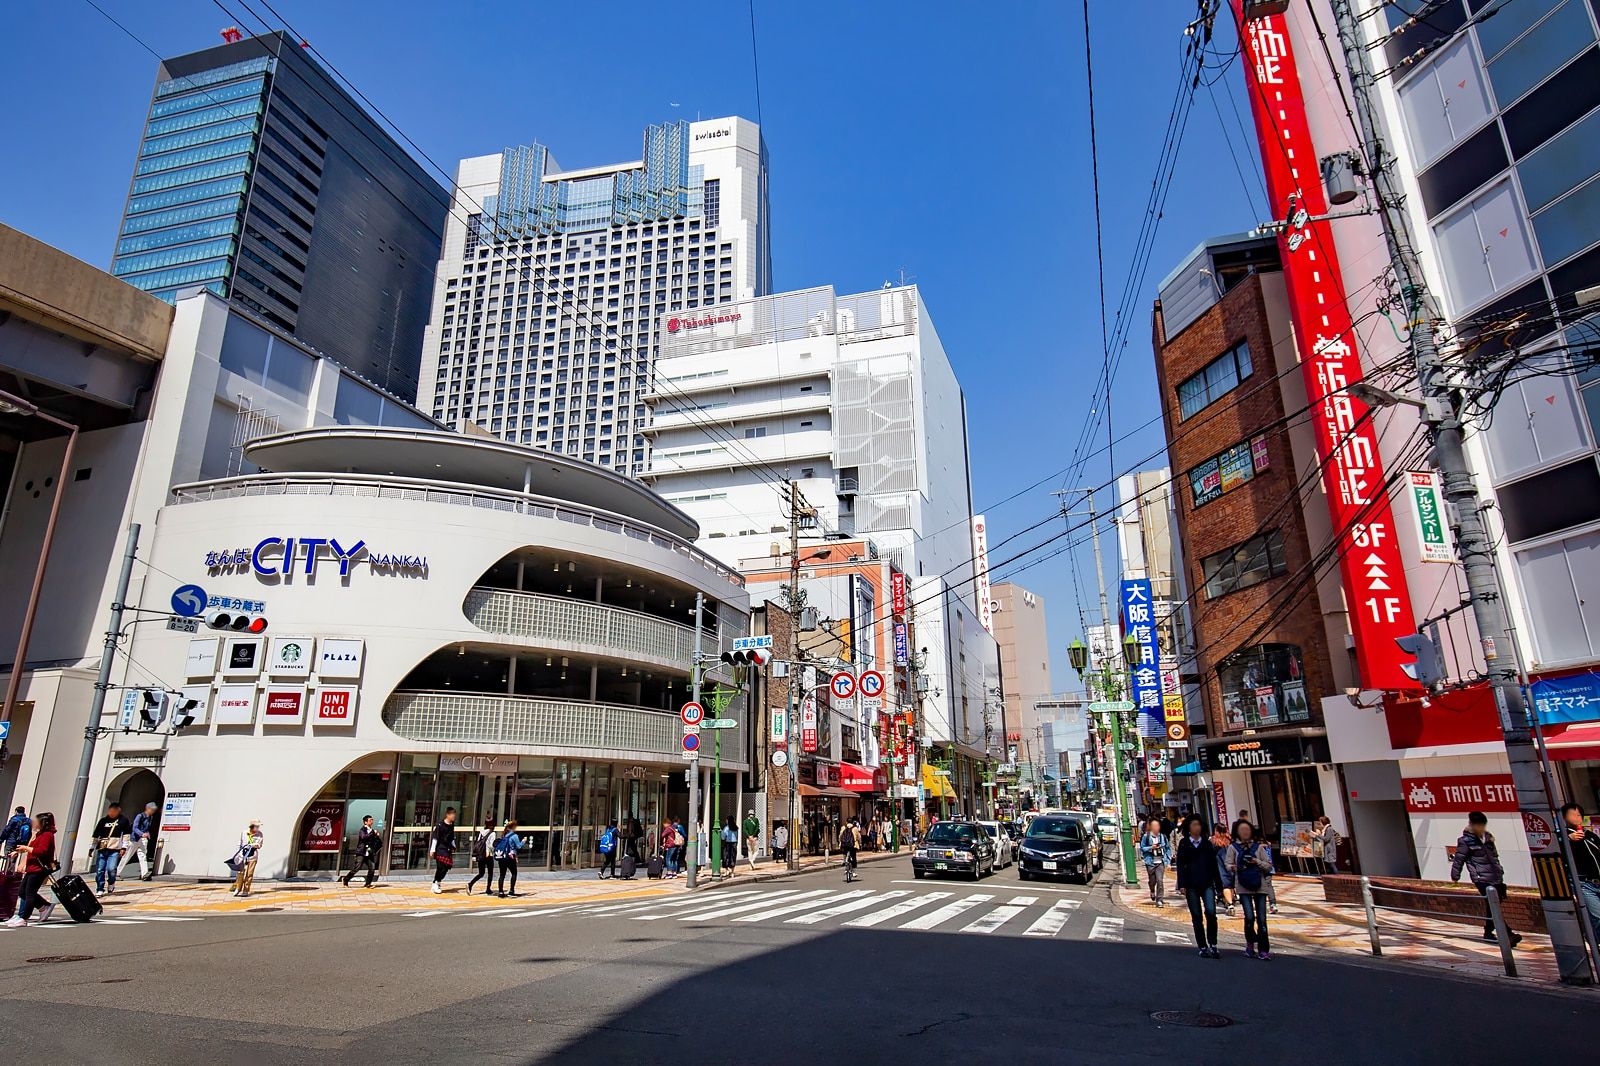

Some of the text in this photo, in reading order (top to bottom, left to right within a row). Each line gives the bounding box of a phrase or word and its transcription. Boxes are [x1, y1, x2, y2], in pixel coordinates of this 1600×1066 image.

[695, 126, 732, 141] swissôtel
[681, 312, 742, 329] Takashimaya
[1315, 362, 1352, 506] TAITO STATION
[1416, 488, 1440, 542] アルサンベール
[1351, 523, 1386, 548] 6F
[205, 537, 428, 576] なんば CITY NANKAI
[977, 536, 991, 633] TAKASHIMAYA
[208, 596, 265, 613] 歩車分離式
[1365, 597, 1401, 623] 1F
[734, 636, 772, 649] 歩車分離式
[1125, 583, 1160, 709] 大阪信用金庫
[323, 653, 357, 661] PLAZA
[324, 694, 345, 705] UNI
[1535, 694, 1600, 713] 電子マネー
[322, 705, 345, 716] QLO
[686, 708, 699, 719] 40
[461, 755, 498, 770] CITY
[1217, 749, 1273, 768] サンマルクカフェ
[632, 765, 647, 778] CITY
[1442, 784, 1516, 803] TAITO STA
